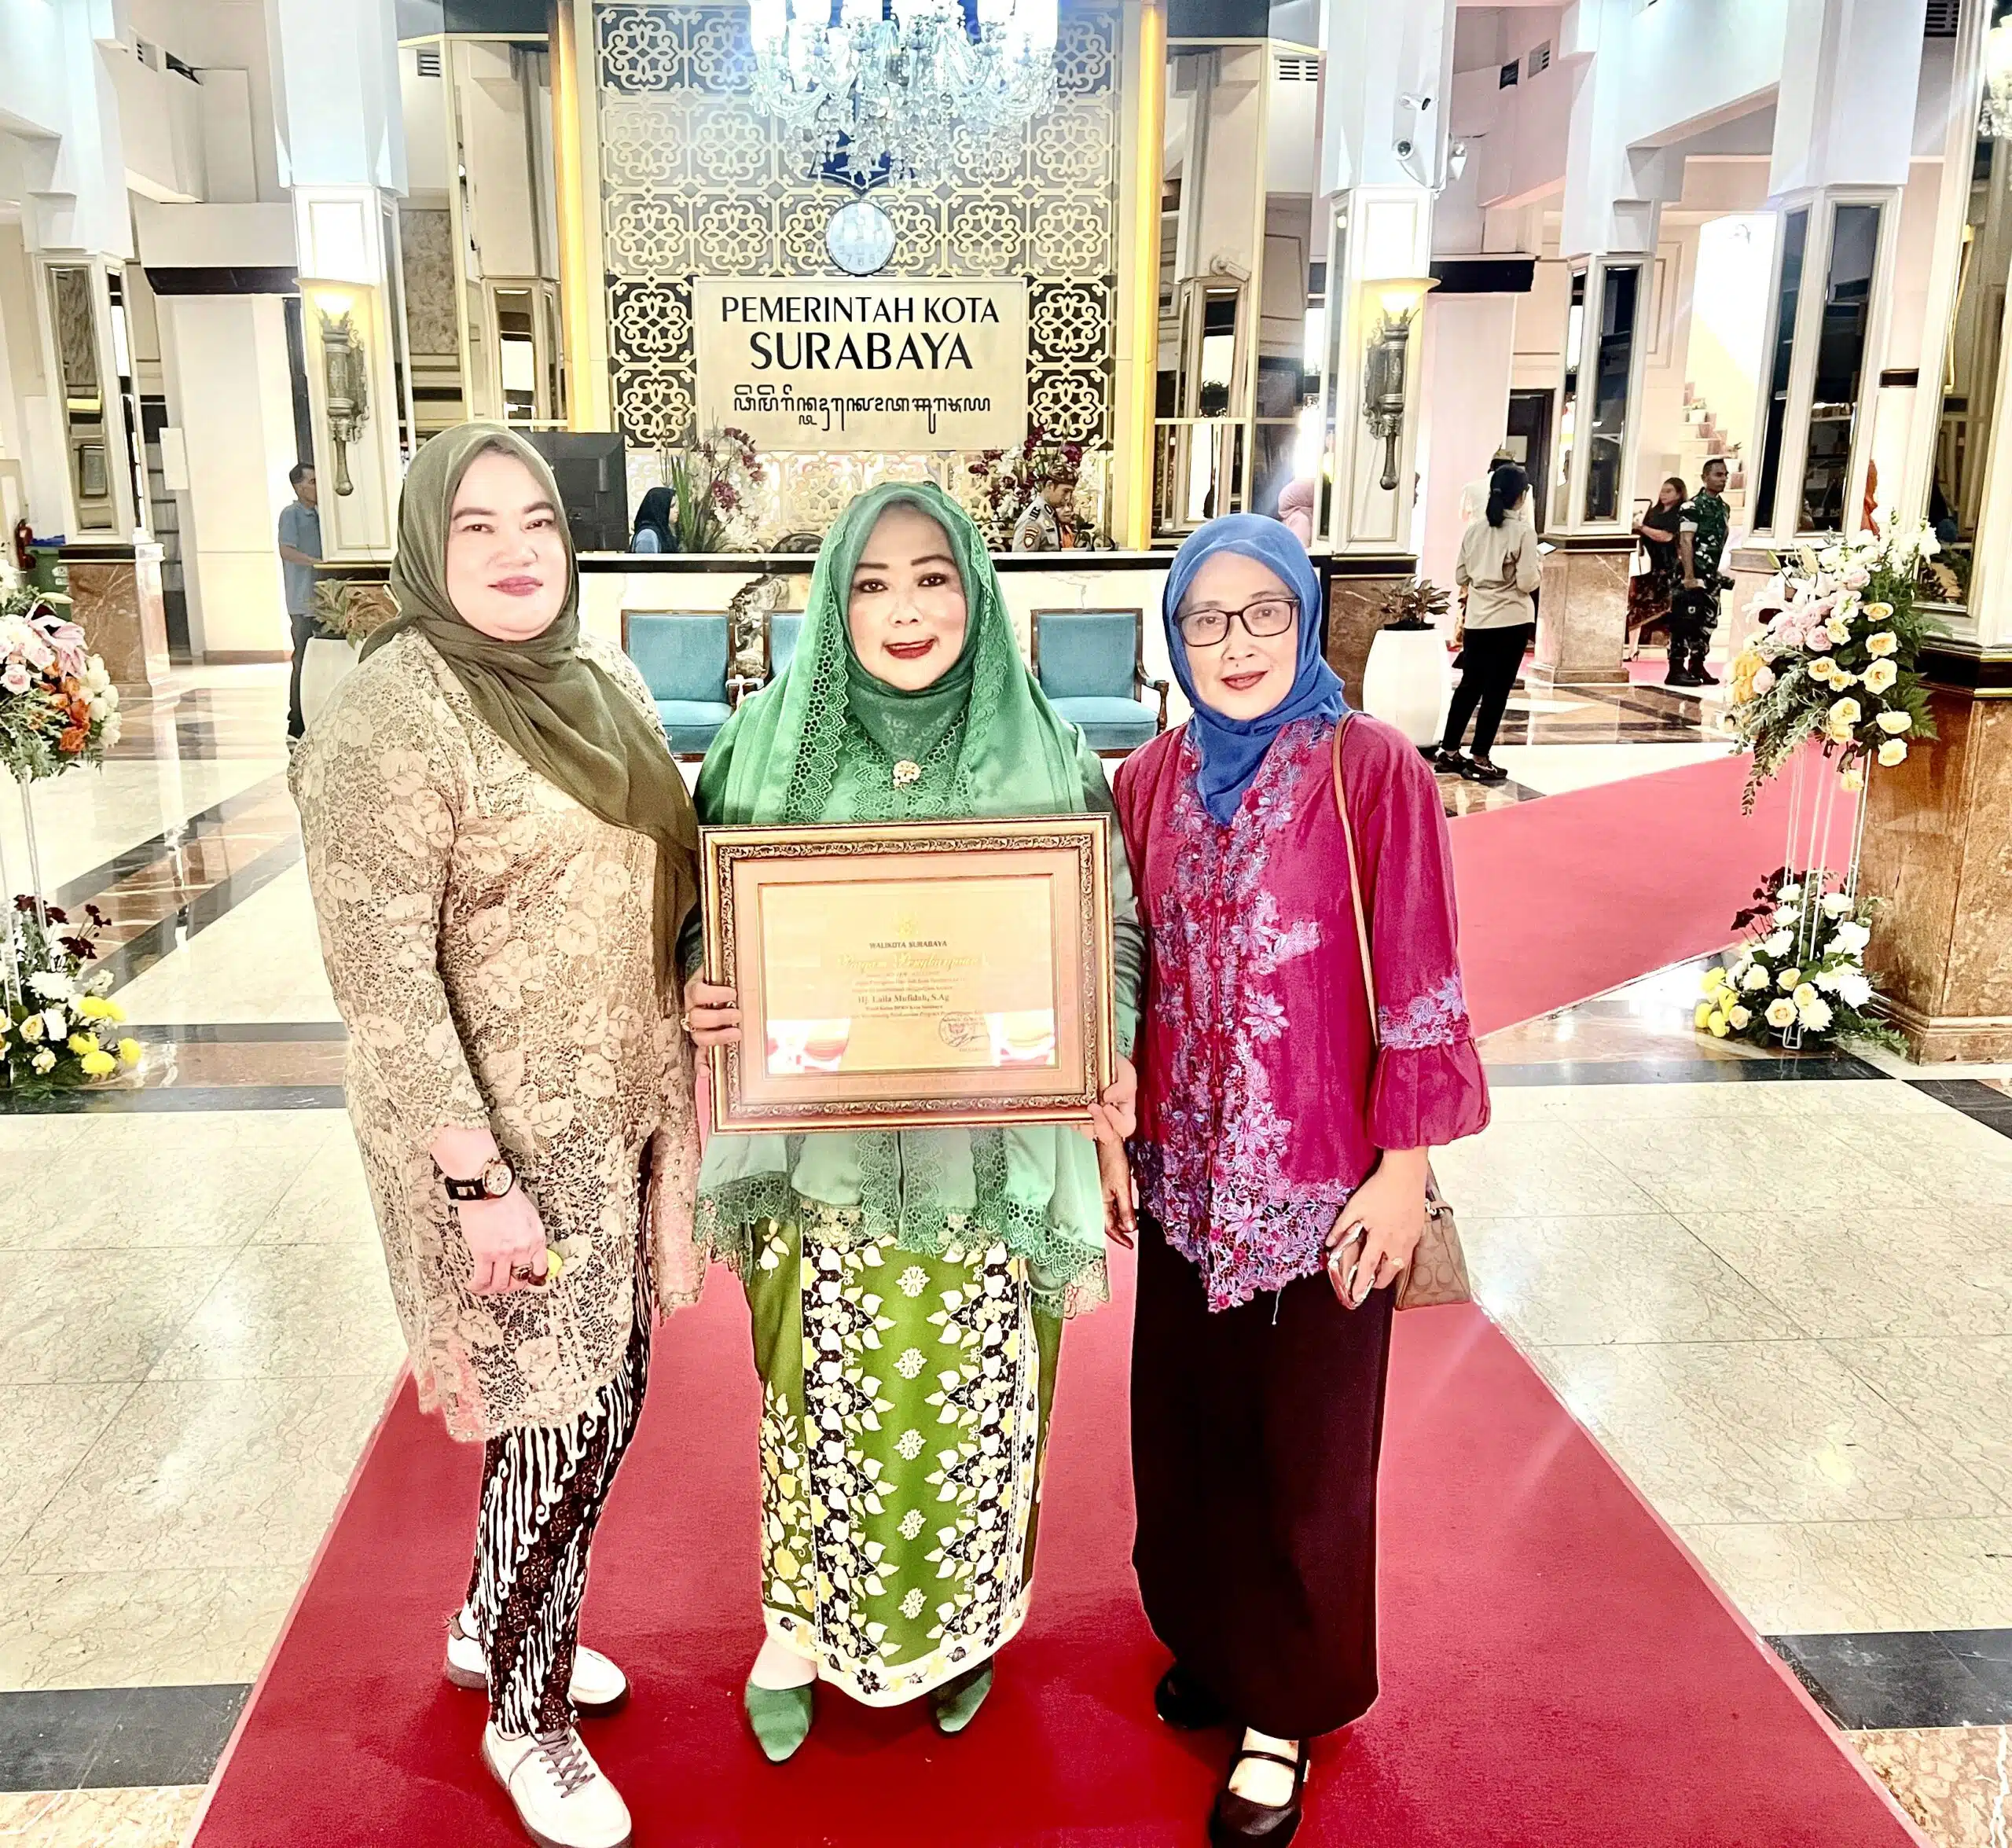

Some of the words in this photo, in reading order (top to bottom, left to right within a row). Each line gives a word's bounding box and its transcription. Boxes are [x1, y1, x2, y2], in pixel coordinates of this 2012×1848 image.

[721, 296, 913, 323] PEMERINTAH
[924, 297, 1000, 323] KOTA
[750, 331, 974, 370] SURABAYA
